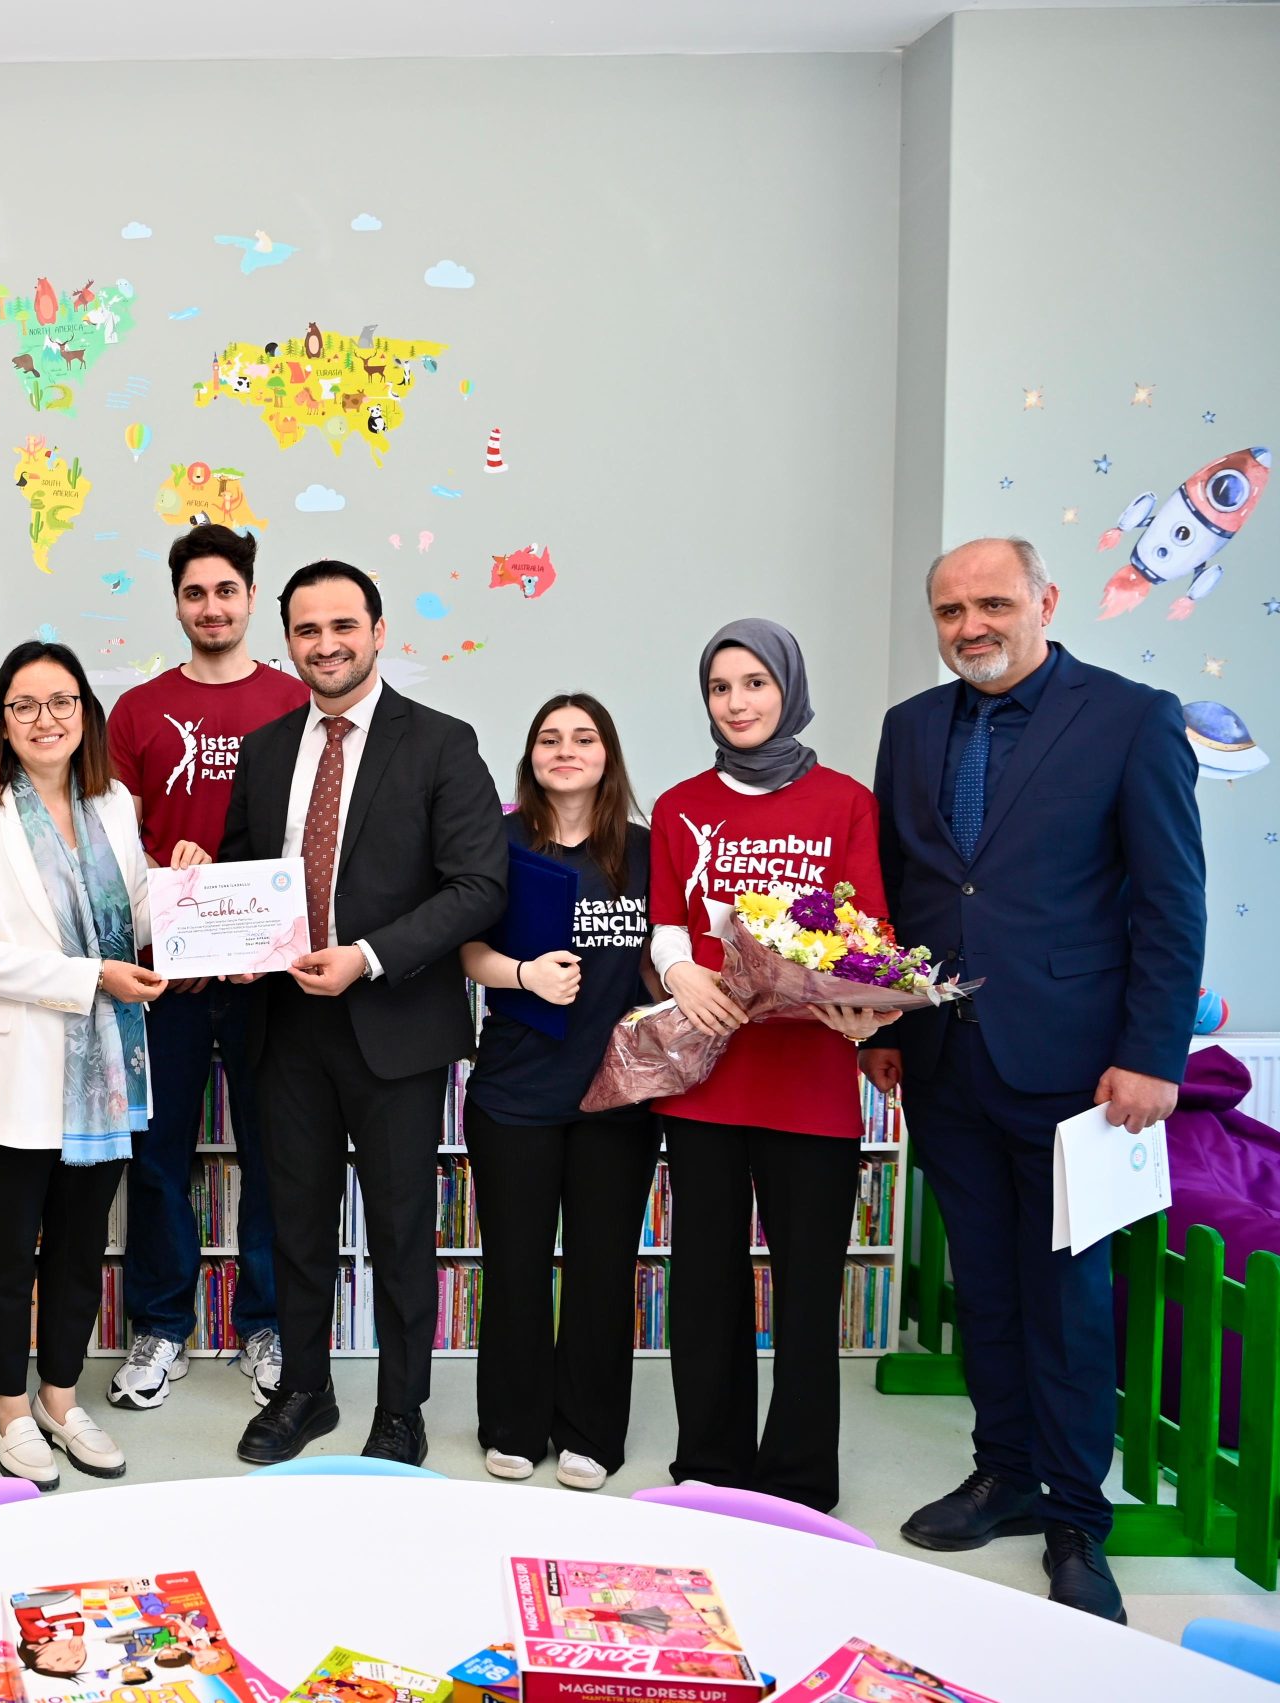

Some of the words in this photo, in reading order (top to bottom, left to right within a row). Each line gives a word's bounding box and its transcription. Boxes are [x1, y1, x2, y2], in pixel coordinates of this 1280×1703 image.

[55, 324, 84, 334] AMERICA
[41, 479, 61, 487] SOUTH
[53, 490, 79, 499] AMERICA
[187, 500, 209, 508] AFRICA
[717, 834, 832, 857] istanbul
[715, 855, 826, 884] GENÇLİK
[572, 935, 645, 948] LATFORM
[521, 1595, 540, 1631] MAGNETIC
[535, 1642, 662, 1676] Barbie
[559, 1682, 643, 1698] MAGNETIC
[646, 1689, 696, 1701] DRESS
[700, 1691, 727, 1702] UP!
